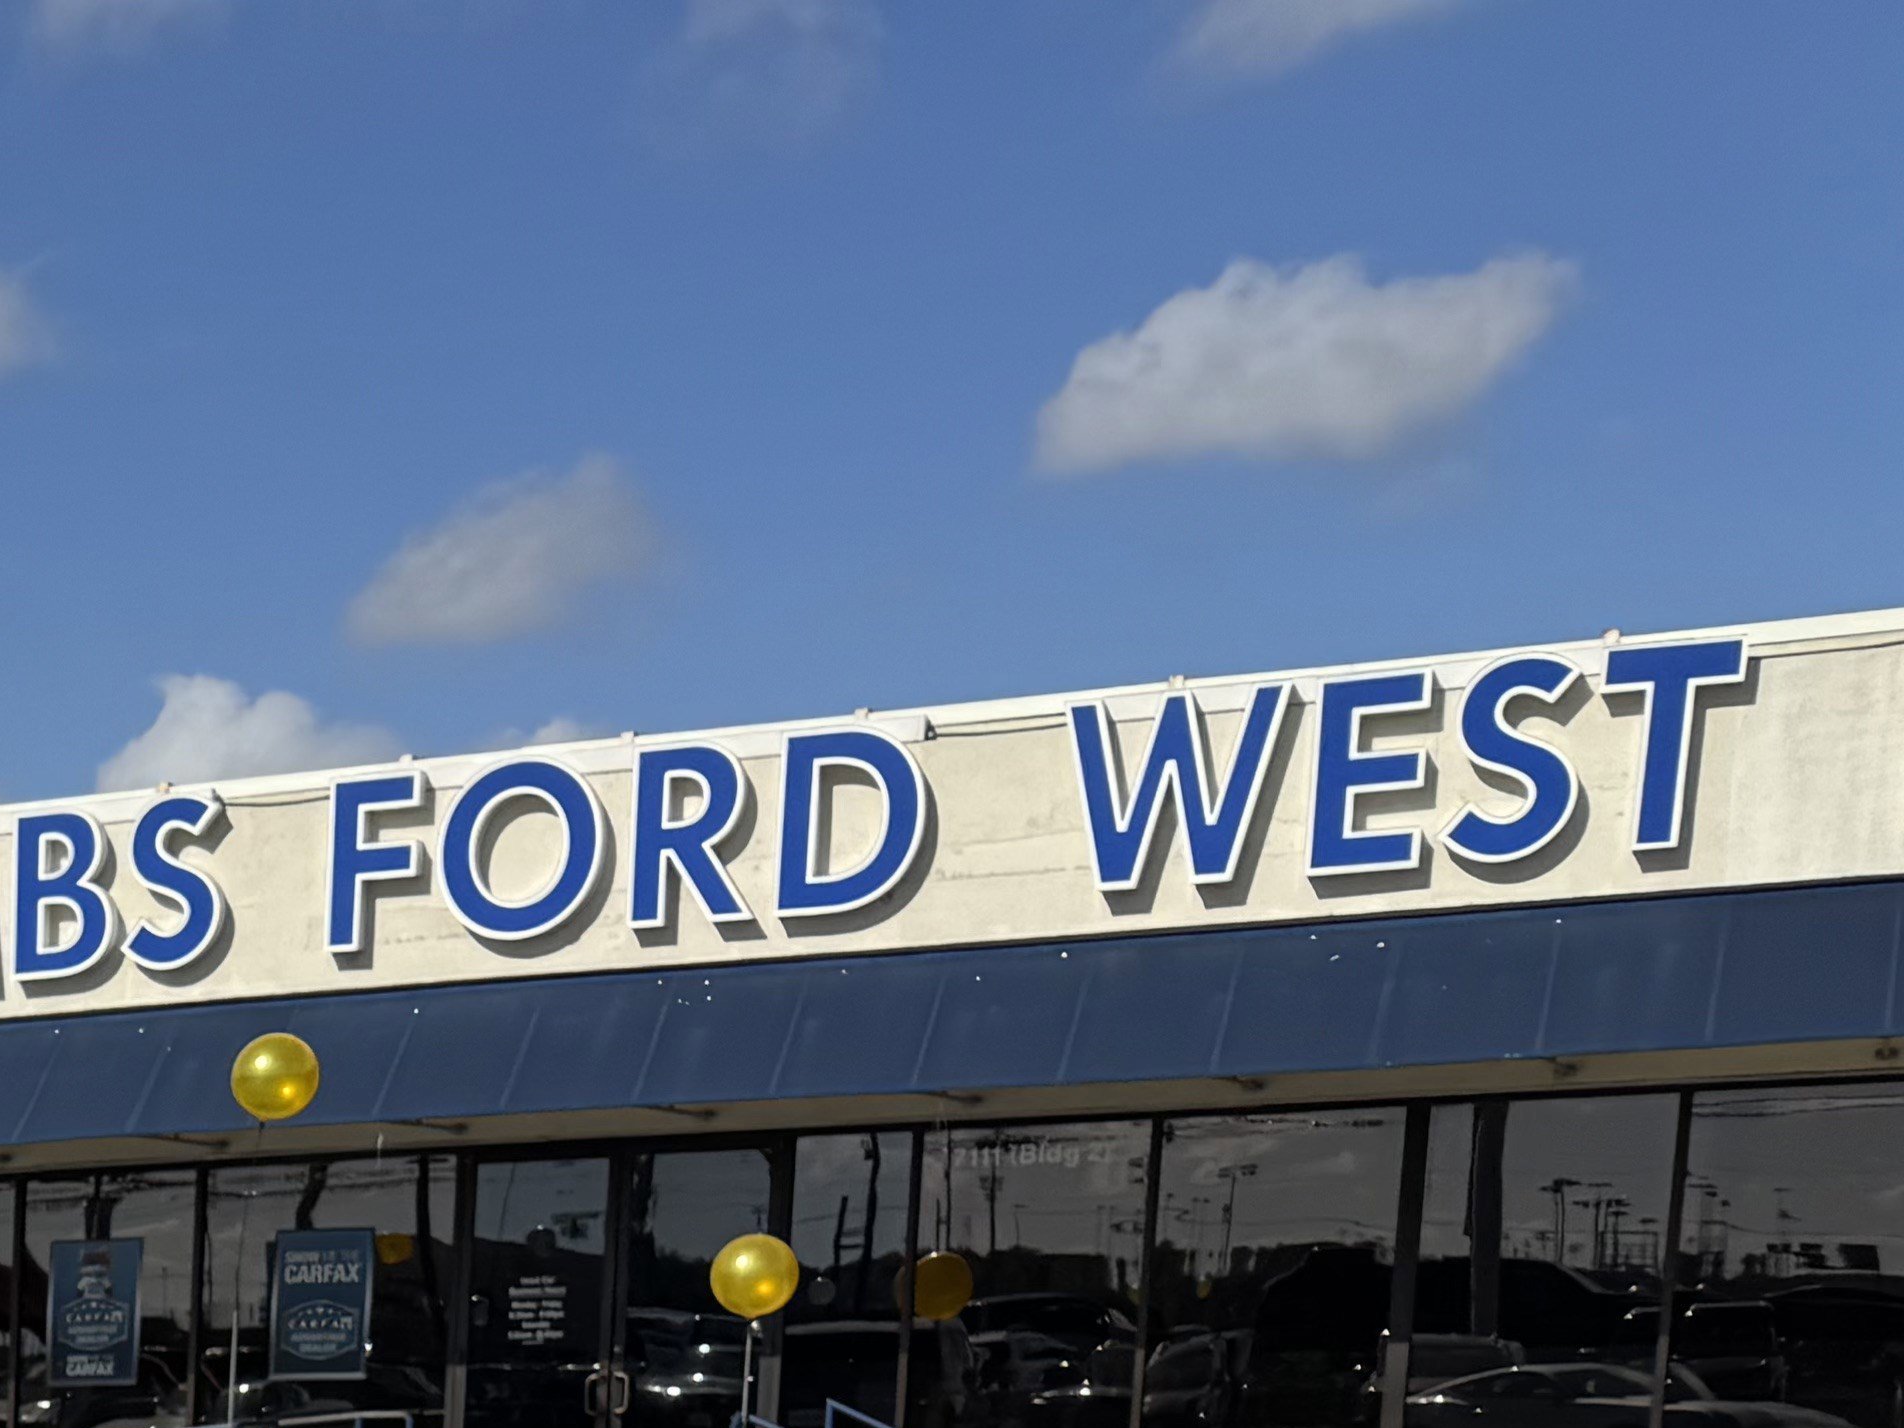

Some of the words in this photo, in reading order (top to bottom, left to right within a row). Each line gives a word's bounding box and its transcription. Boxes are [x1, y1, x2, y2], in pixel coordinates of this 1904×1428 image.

[323, 722, 933, 956] FORD
[1065, 638, 1750, 894] WEST
[284, 1263, 360, 1284] CARFAX
